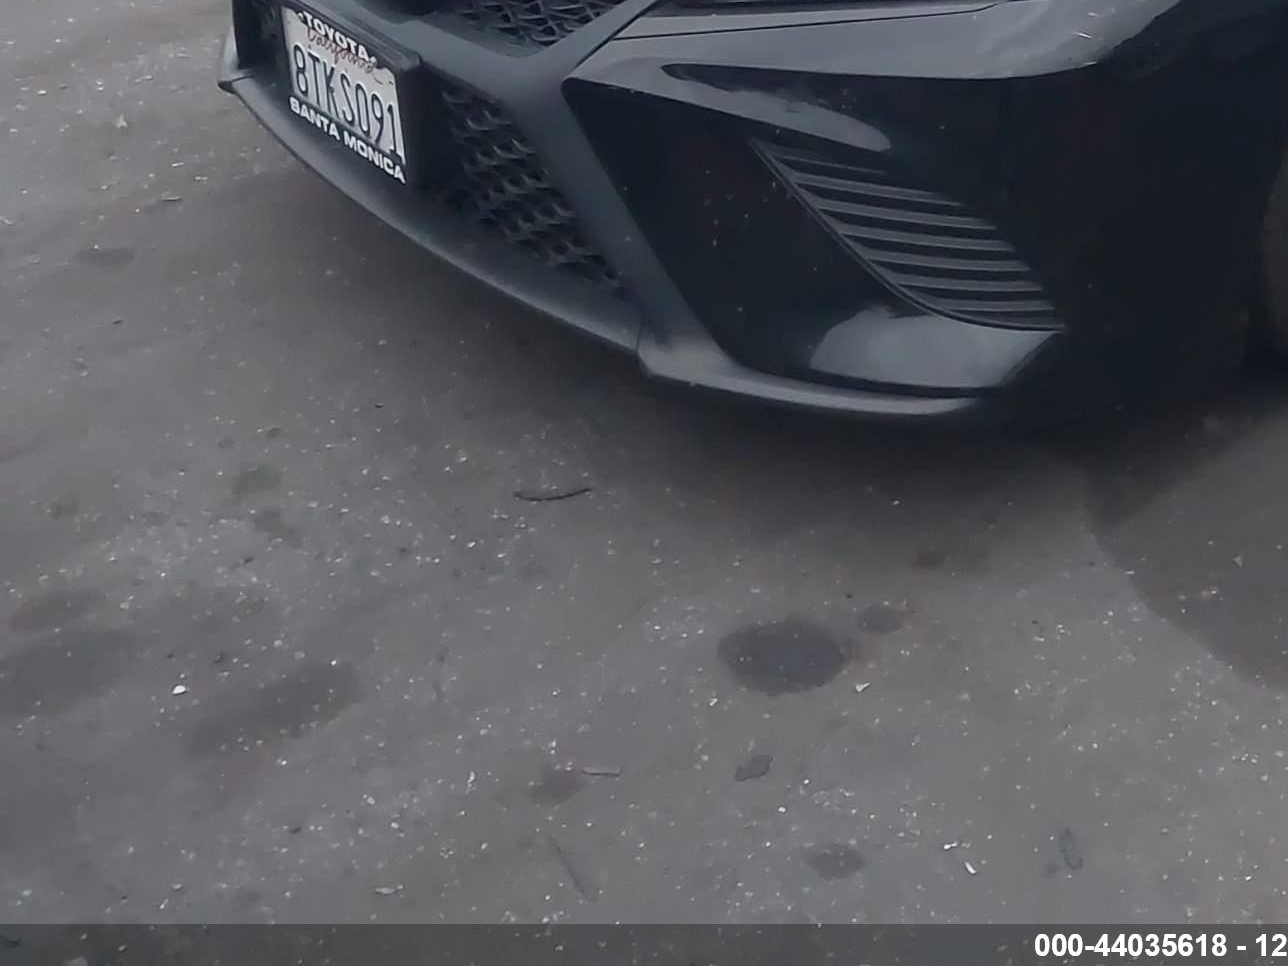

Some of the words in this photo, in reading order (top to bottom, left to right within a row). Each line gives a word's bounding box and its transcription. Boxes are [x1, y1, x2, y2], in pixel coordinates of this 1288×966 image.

[303, 10, 369, 62] TOYOTA
[289, 96, 341, 141] SANTA
[344, 130, 406, 184] MONICA
[293, 42, 404, 157] 8TKS091
